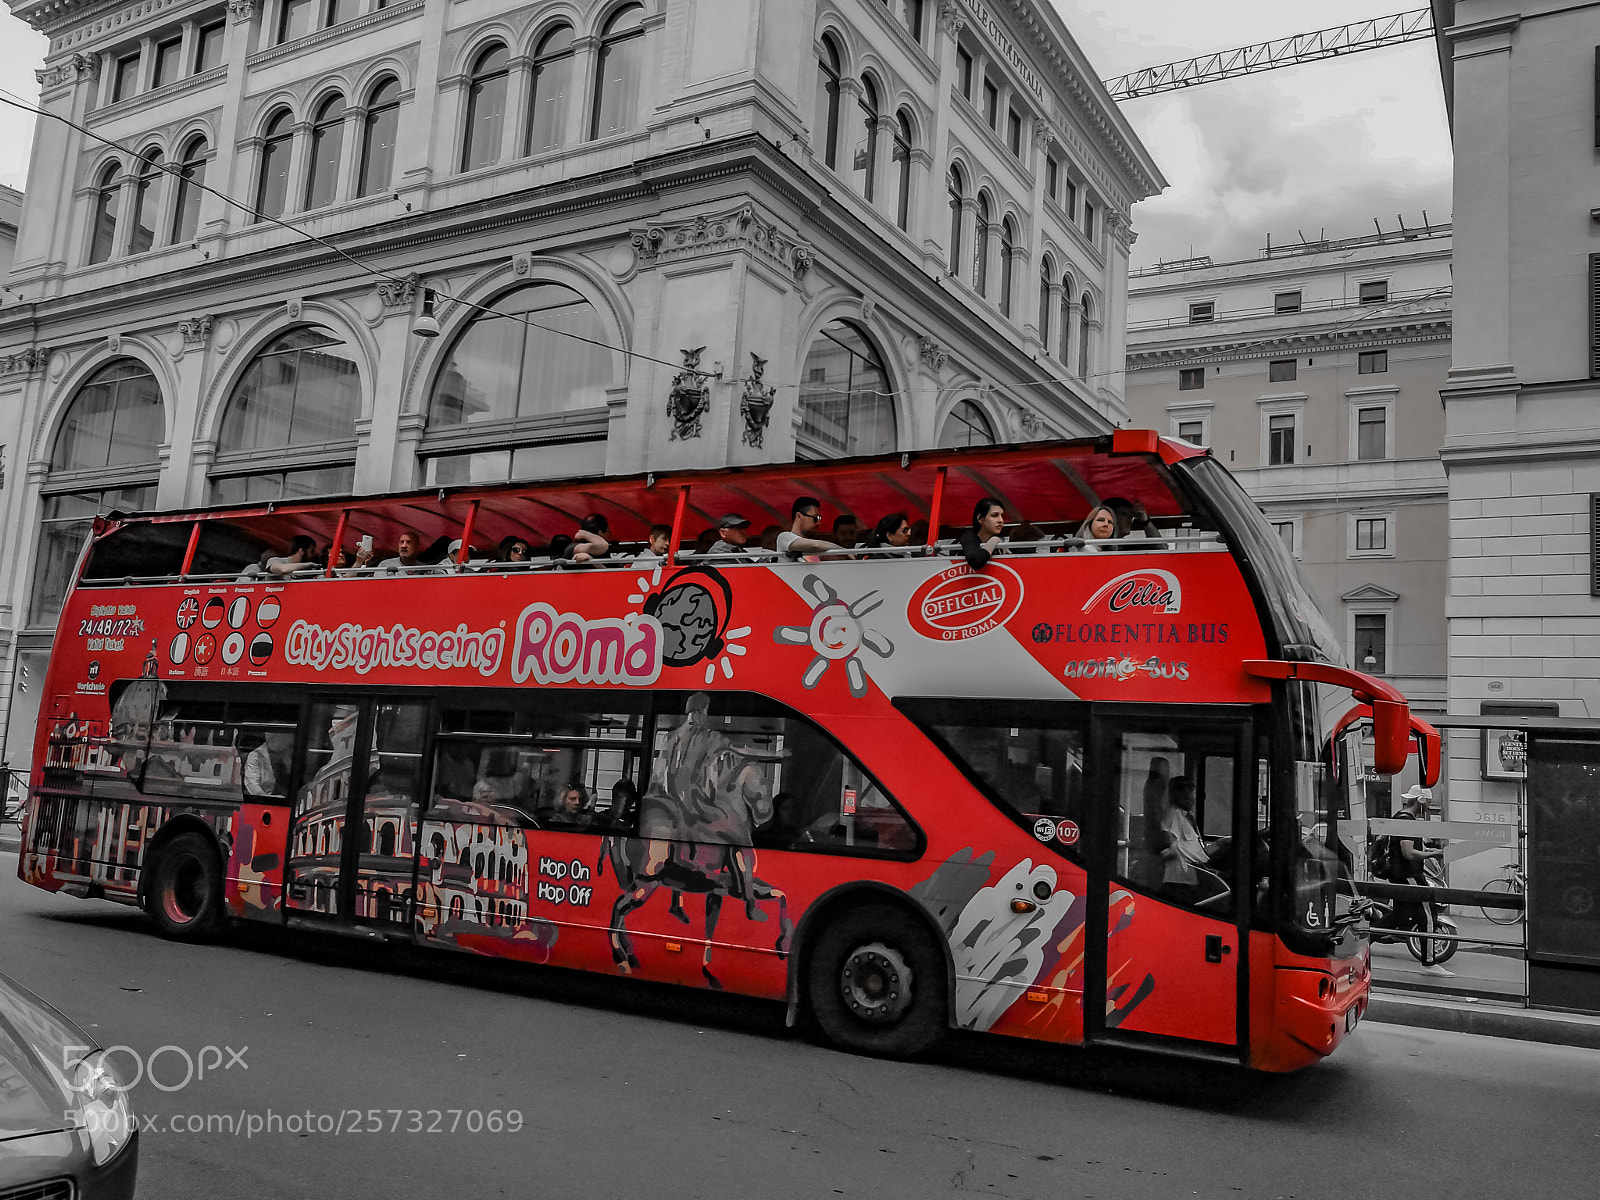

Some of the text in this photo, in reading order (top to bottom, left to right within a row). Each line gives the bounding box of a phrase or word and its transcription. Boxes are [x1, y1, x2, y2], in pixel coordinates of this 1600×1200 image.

[924, 587, 1001, 617] OFFICIAL
[1109, 580, 1175, 612] Cilia
[941, 617, 998, 640] OF ROMA
[1054, 623, 1229, 643] FLORENTIA BUS
[511, 602, 664, 686] Roma
[1058, 826, 1078, 838] 107
[540, 857, 590, 880] Hop On
[538, 882, 592, 906] Hop Off
